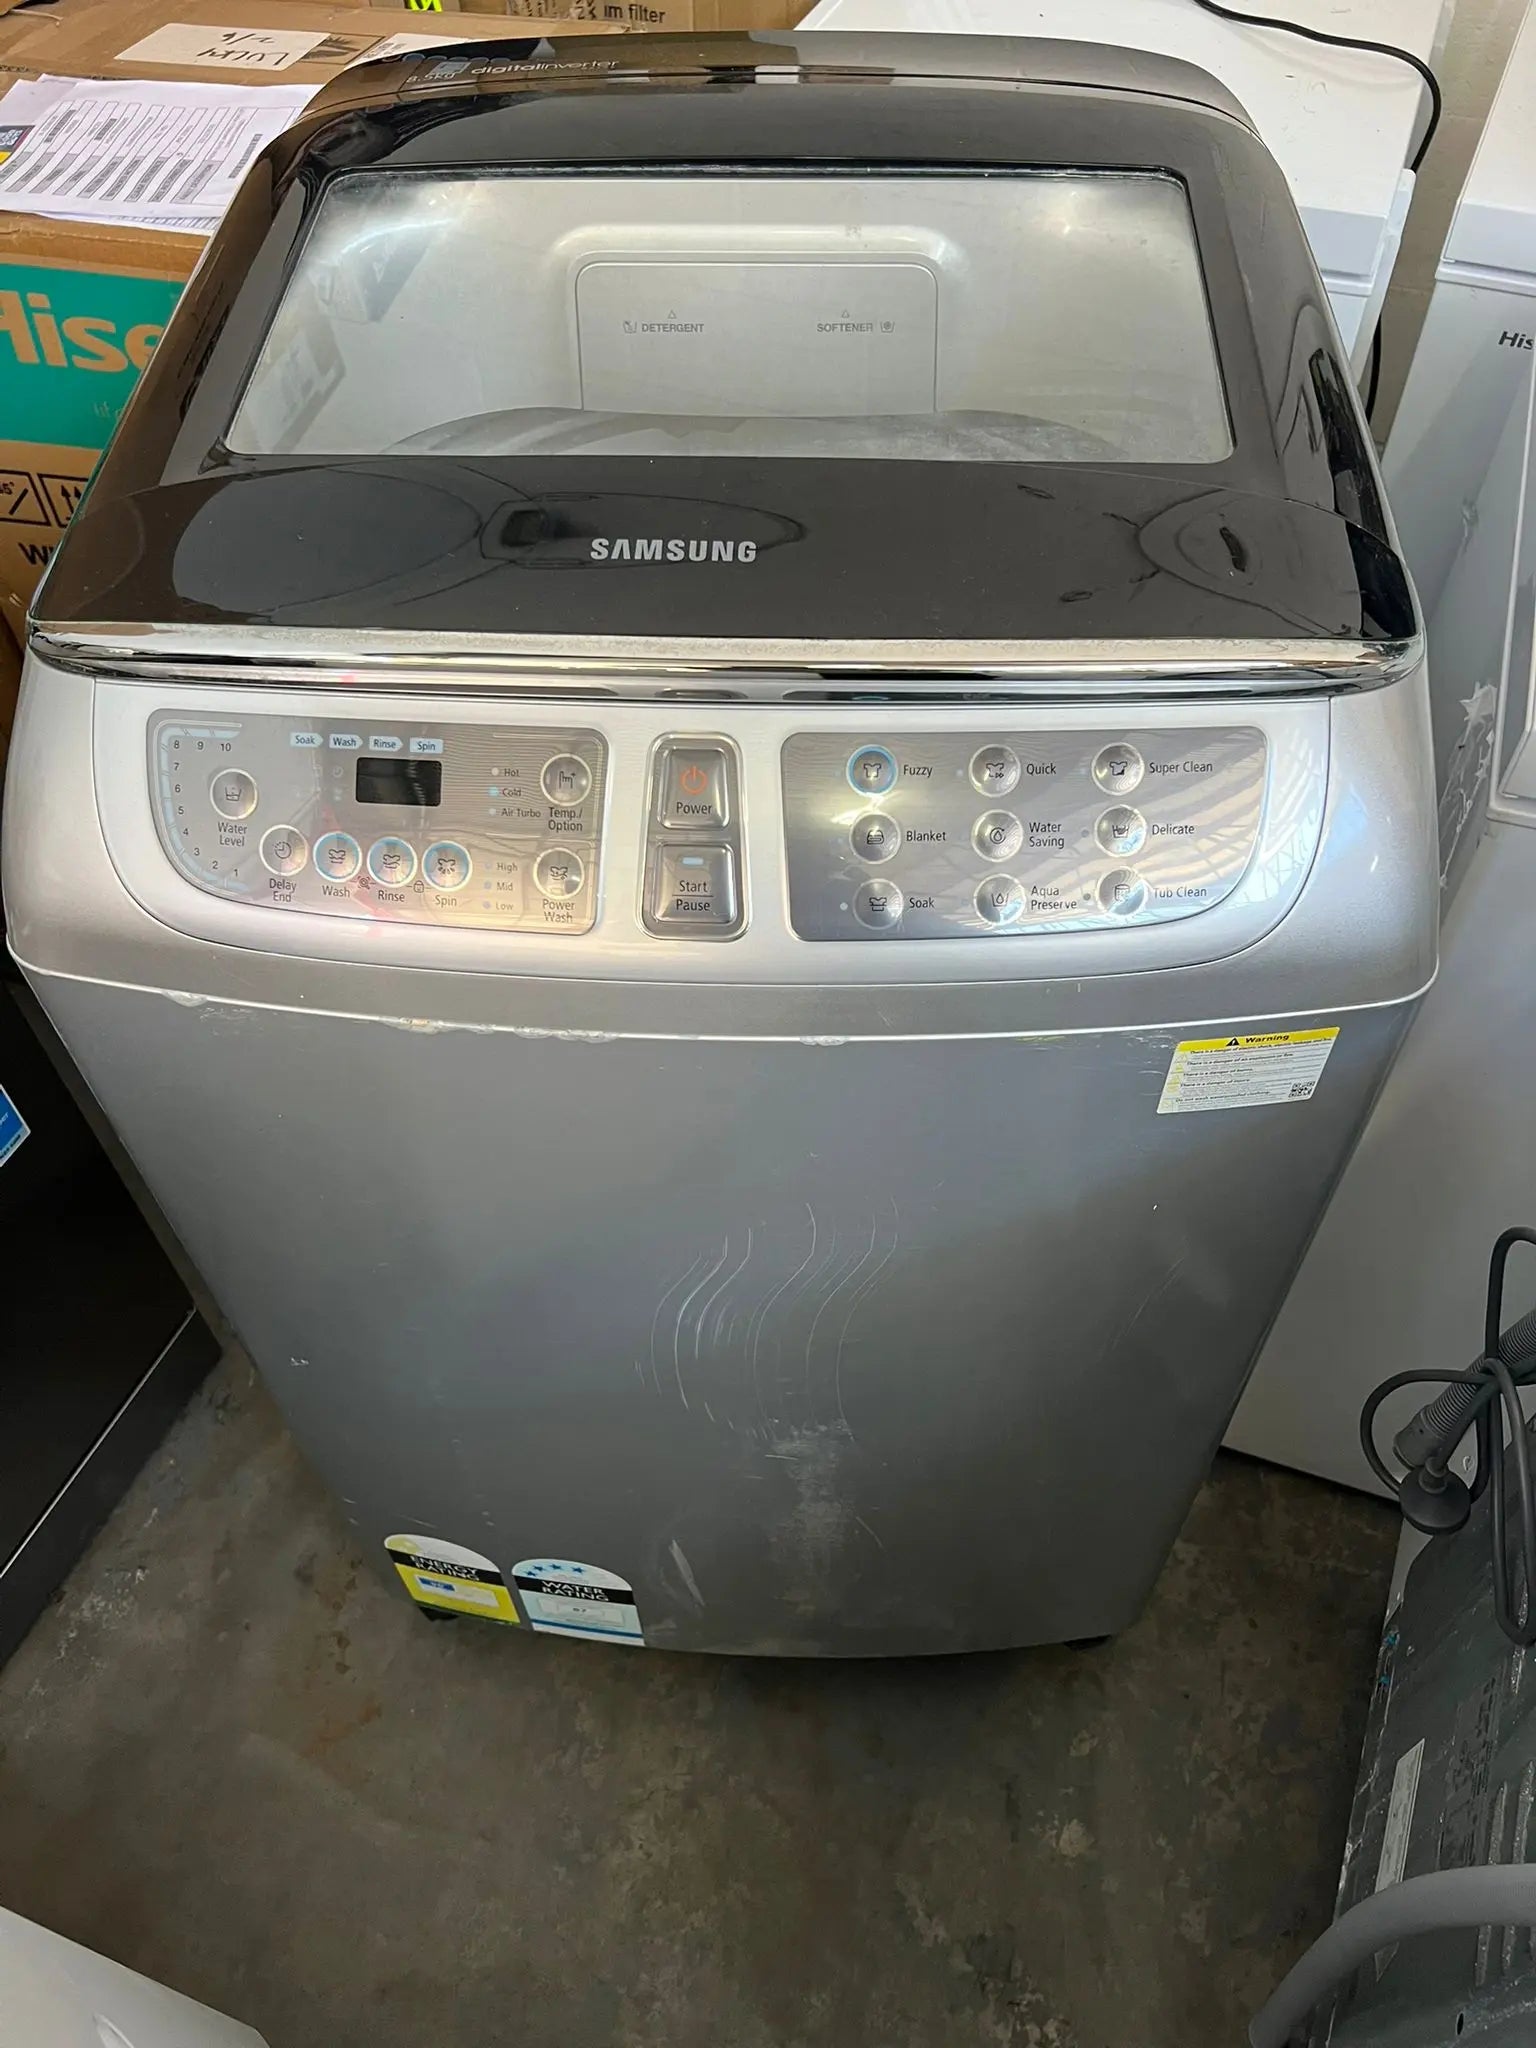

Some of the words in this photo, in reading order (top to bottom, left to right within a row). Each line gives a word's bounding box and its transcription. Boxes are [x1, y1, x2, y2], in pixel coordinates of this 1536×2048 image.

[628, 4, 665, 23] filter
[641, 322, 704, 333] DETERGENT
[816, 322, 873, 333] SOFTENER
[1498, 331, 1535, 350] His
[590, 537, 757, 563] SAMSUNG
[173, 740, 180, 749] 8
[197, 741, 204, 750] 9
[220, 743, 232, 752] 10
[295, 735, 316, 745] Soak
[333, 737, 357, 747] Wash
[374, 739, 397, 749] Rinse
[418, 742, 436, 751] Spin
[174, 762, 180, 771] 7
[504, 768, 519, 777] Hot
[902, 764, 933, 778] Fuzzy
[1026, 763, 1057, 775] Quick
[1149, 762, 1180, 776] Super
[1182, 760, 1213, 773] Clean
[174, 784, 181, 793] 6
[502, 788, 521, 797] Cold
[178, 806, 184, 815] 5
[501, 808, 514, 817] Air
[517, 808, 541, 818] Turbo
[548, 806, 583, 821] Temp./
[676, 801, 713, 815] Power
[217, 822, 247, 834] Water
[548, 819, 583, 833] Option
[1028, 822, 1062, 833] Water
[1151, 823, 1195, 835] Delicate
[183, 828, 189, 837] 4
[906, 830, 946, 842] Blanket
[219, 835, 245, 847] Level
[1028, 836, 1065, 849] Saving
[193, 848, 200, 857] 3
[212, 861, 219, 870] 2
[496, 862, 518, 873] High
[234, 869, 239, 877] 1
[269, 878, 297, 893] Delay
[322, 885, 351, 898] Wash
[496, 882, 514, 892] Mid
[679, 880, 709, 893] Start
[1030, 885, 1060, 898] Aqua
[273, 891, 292, 902] End
[377, 889, 406, 903] Rinse
[1153, 888, 1174, 900] Tub
[1176, 887, 1207, 898] Clean
[435, 894, 458, 908] Spin
[495, 901, 515, 911] Low
[542, 898, 576, 912] Power
[676, 898, 711, 912] Pause
[909, 897, 935, 909] Soak
[1031, 899, 1077, 910] Preserve
[543, 911, 573, 924] Wash
[1245, 1034, 1290, 1044] Warning
[410, 1556, 477, 1574] ENERGY
[415, 1563, 480, 1581] RATING
[542, 1581, 604, 1595] WATER
[542, 1587, 609, 1601] RATING
